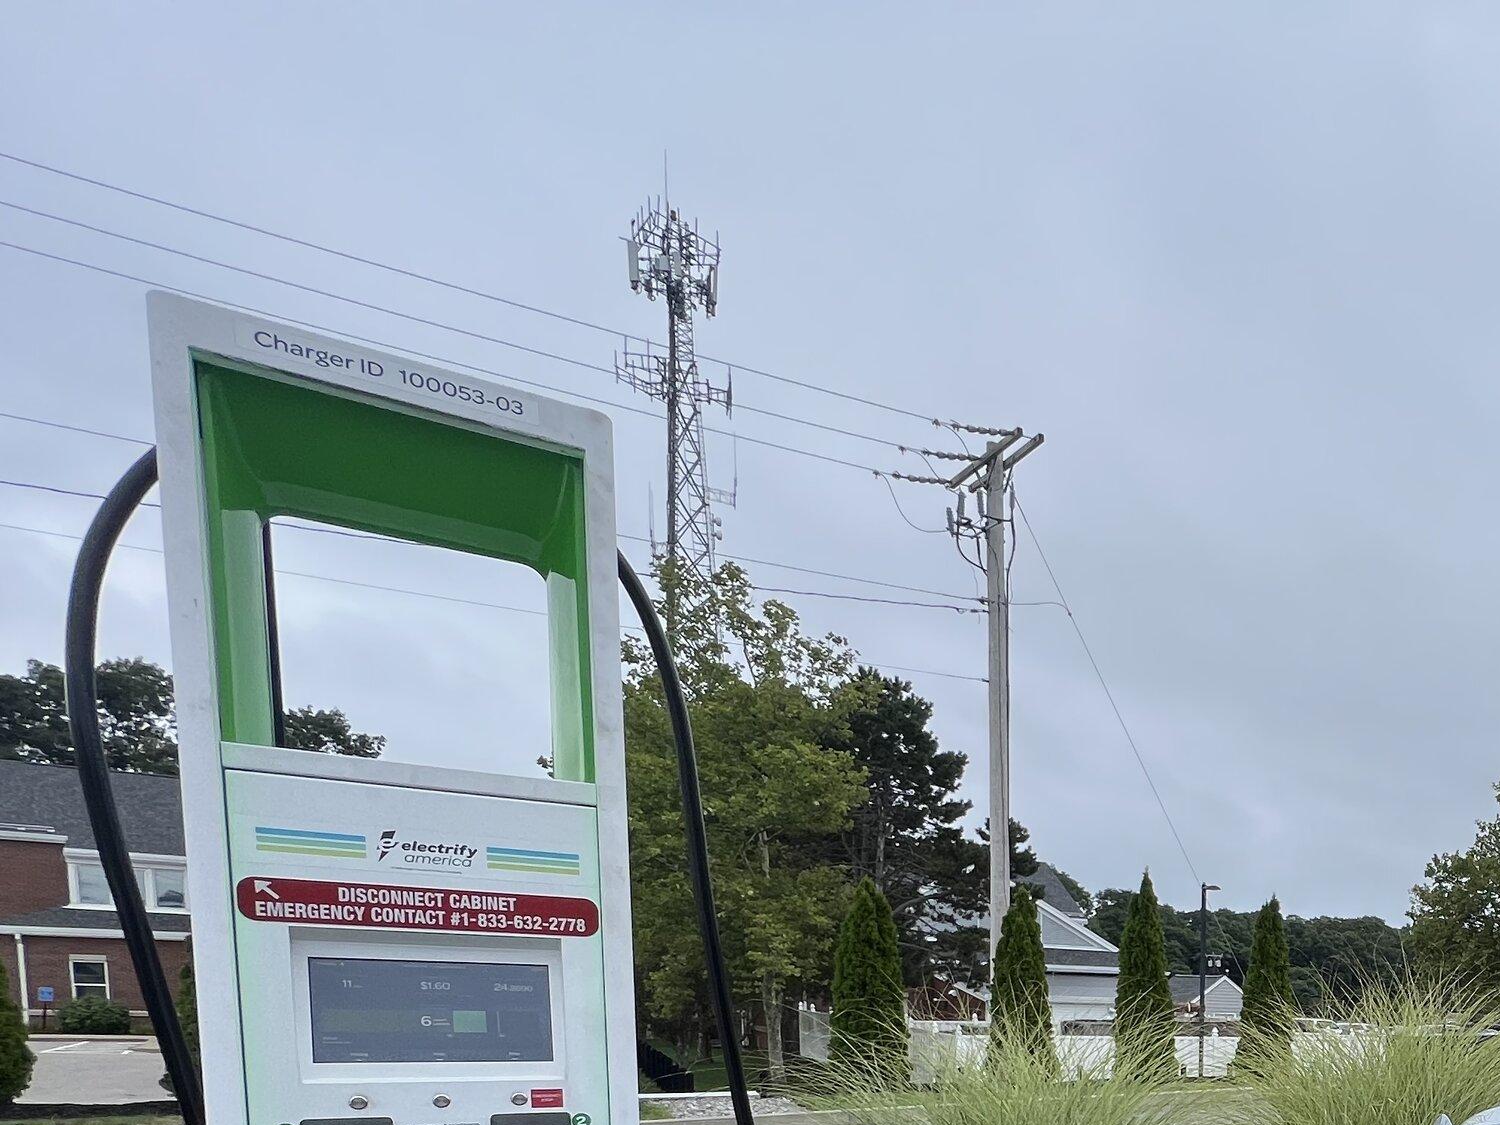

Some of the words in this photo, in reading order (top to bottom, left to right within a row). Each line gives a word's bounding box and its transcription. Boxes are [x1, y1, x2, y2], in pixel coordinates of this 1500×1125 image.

[254, 331, 354, 367] Charger
[361, 358, 384, 377] ID
[399, 369, 523, 416] 100053-03
[401, 840, 478, 859] electrify
[404, 853, 472, 868] america
[338, 886, 444, 908] DISCONNECT
[449, 894, 517, 912] CABINET
[255, 901, 365, 922] EMERGENCY
[370, 907, 446, 925] CONTACT
[450, 912, 586, 932] #1-833-632-2778
